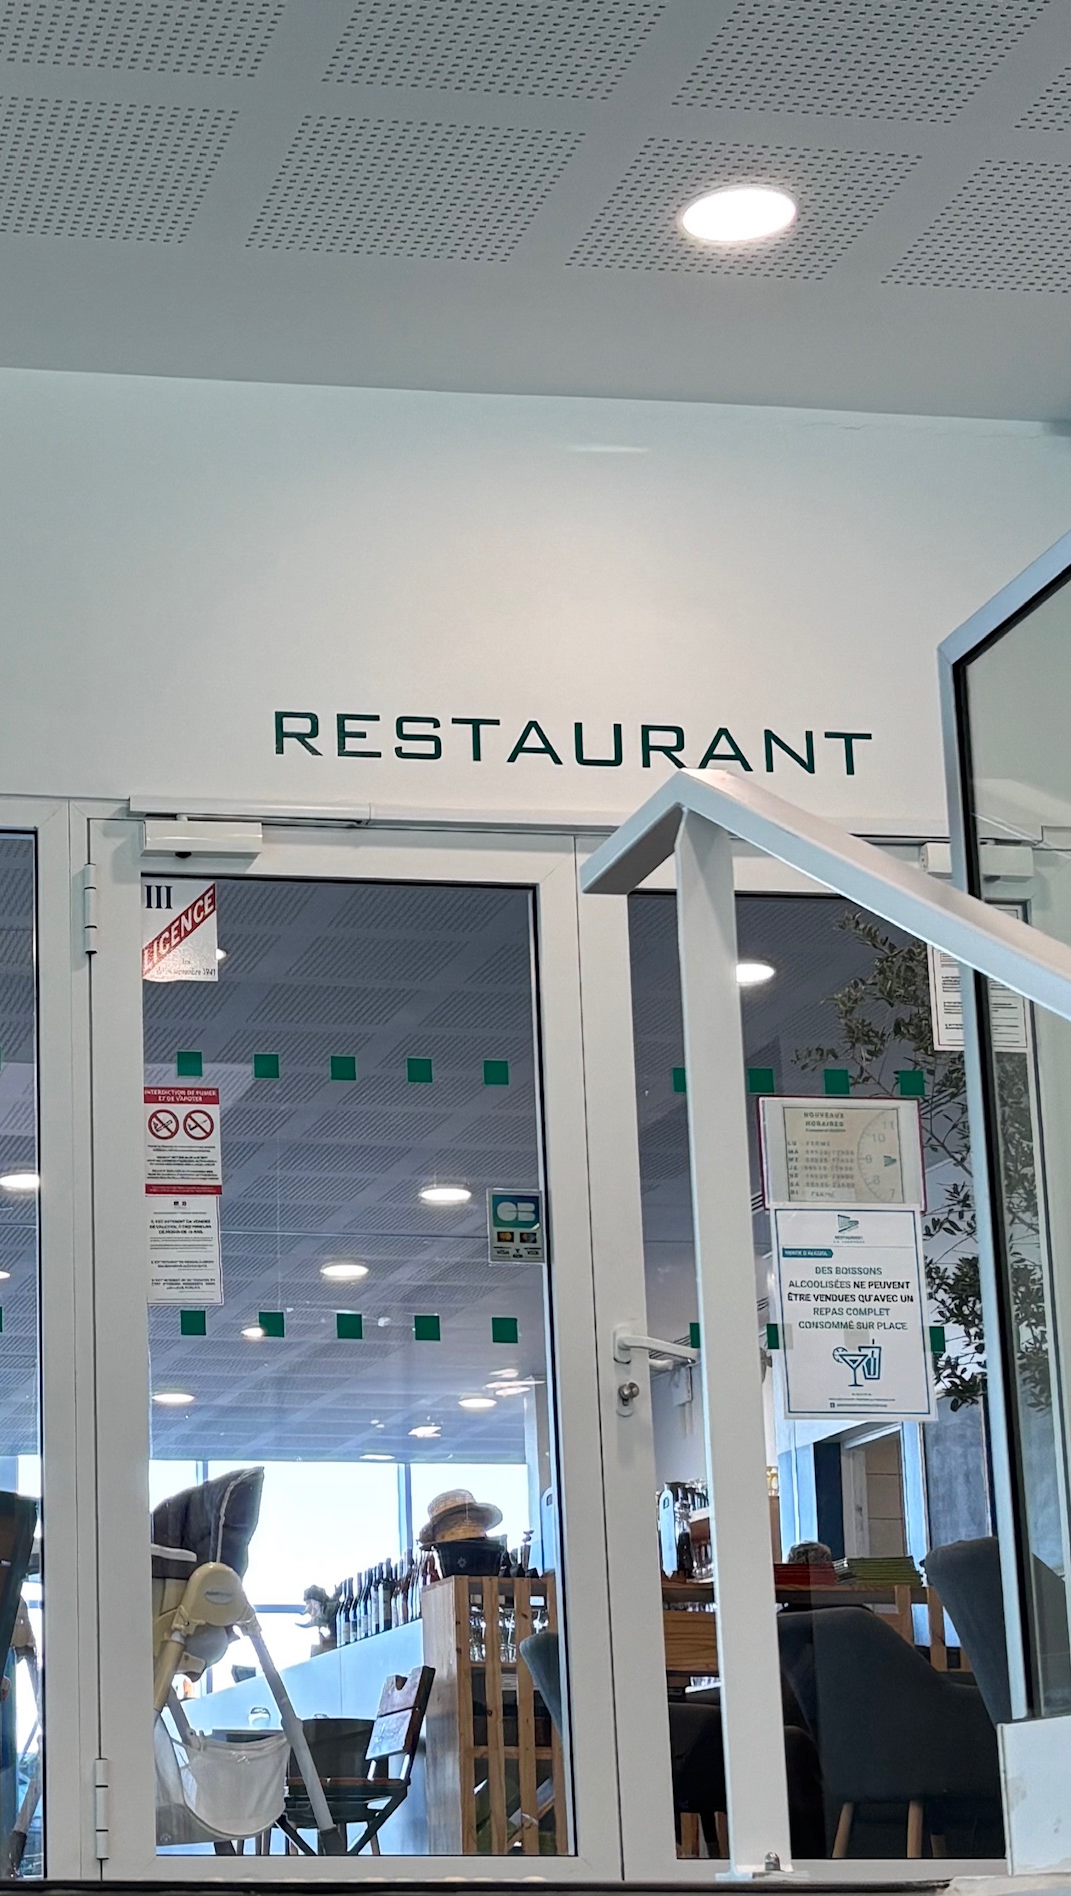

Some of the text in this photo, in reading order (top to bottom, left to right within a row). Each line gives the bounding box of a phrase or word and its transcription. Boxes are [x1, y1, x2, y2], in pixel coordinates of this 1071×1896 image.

[274, 711, 873, 775] RESTAURANT
[145, 885, 173, 909] III
[143, 888, 214, 971] LICENCE
[872, 1133, 886, 1143] 10
[865, 1154, 873, 1164] 9
[873, 1175, 881, 1185] 8
[889, 1188, 895, 1199] 7
[497, 1201, 536, 1222] CB
[815, 1267, 883, 1275] DES BOISSONS
[789, 1279, 910, 1289] ALCOOLISÉES NE PEUVENT
[787, 1292, 914, 1303] ÊTRE VENDUES QU'AVEC UN
[813, 1307, 890, 1316] REPAS COMPLET
[798, 1319, 909, 1330] CONSOMMÉ SUR PLACE
